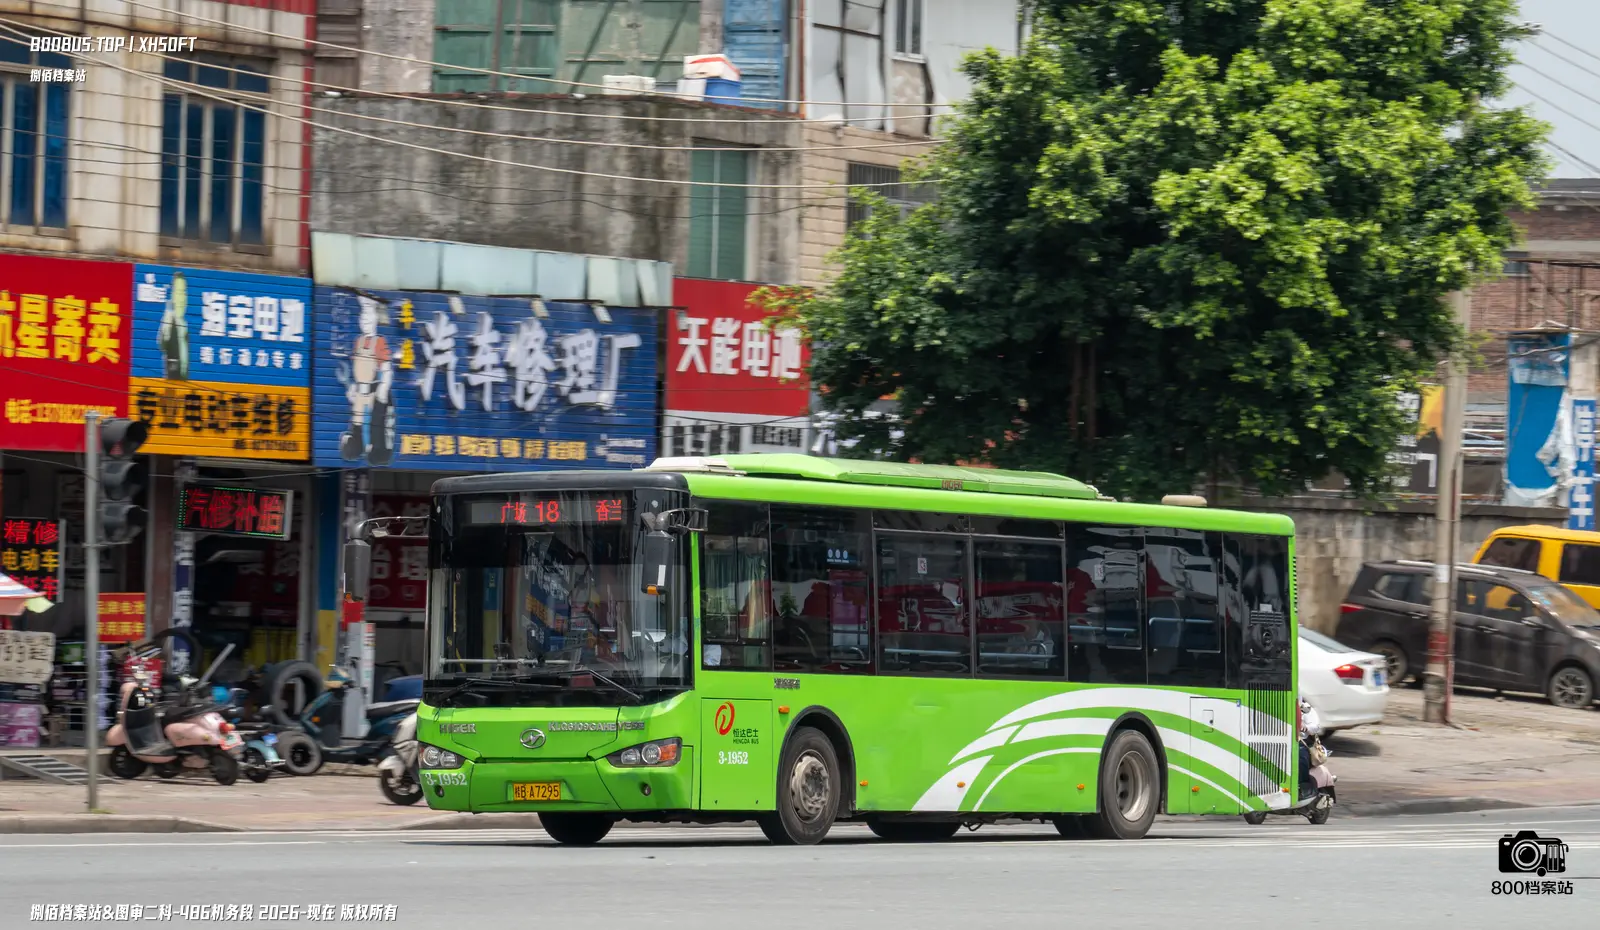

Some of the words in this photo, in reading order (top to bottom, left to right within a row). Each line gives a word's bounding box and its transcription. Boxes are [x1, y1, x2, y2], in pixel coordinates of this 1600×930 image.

[200, 291, 305, 343] 海宝电池
[676, 317, 801, 379] 天能电池
[417, 310, 643, 412] 汽车修理厂
[184, 487, 286, 533] 汽修补胎
[500, 501, 528, 523] 广场
[535, 500, 559, 522] 18
[595, 499, 622, 522] 香兰
[3, 519, 59, 545] 精修
[1, 547, 60, 572] 电动车
[733, 728, 759, 738] 恒达巴士
[718, 751, 749, 765] 3-1952
[424, 772, 468, 786] 3-1952
